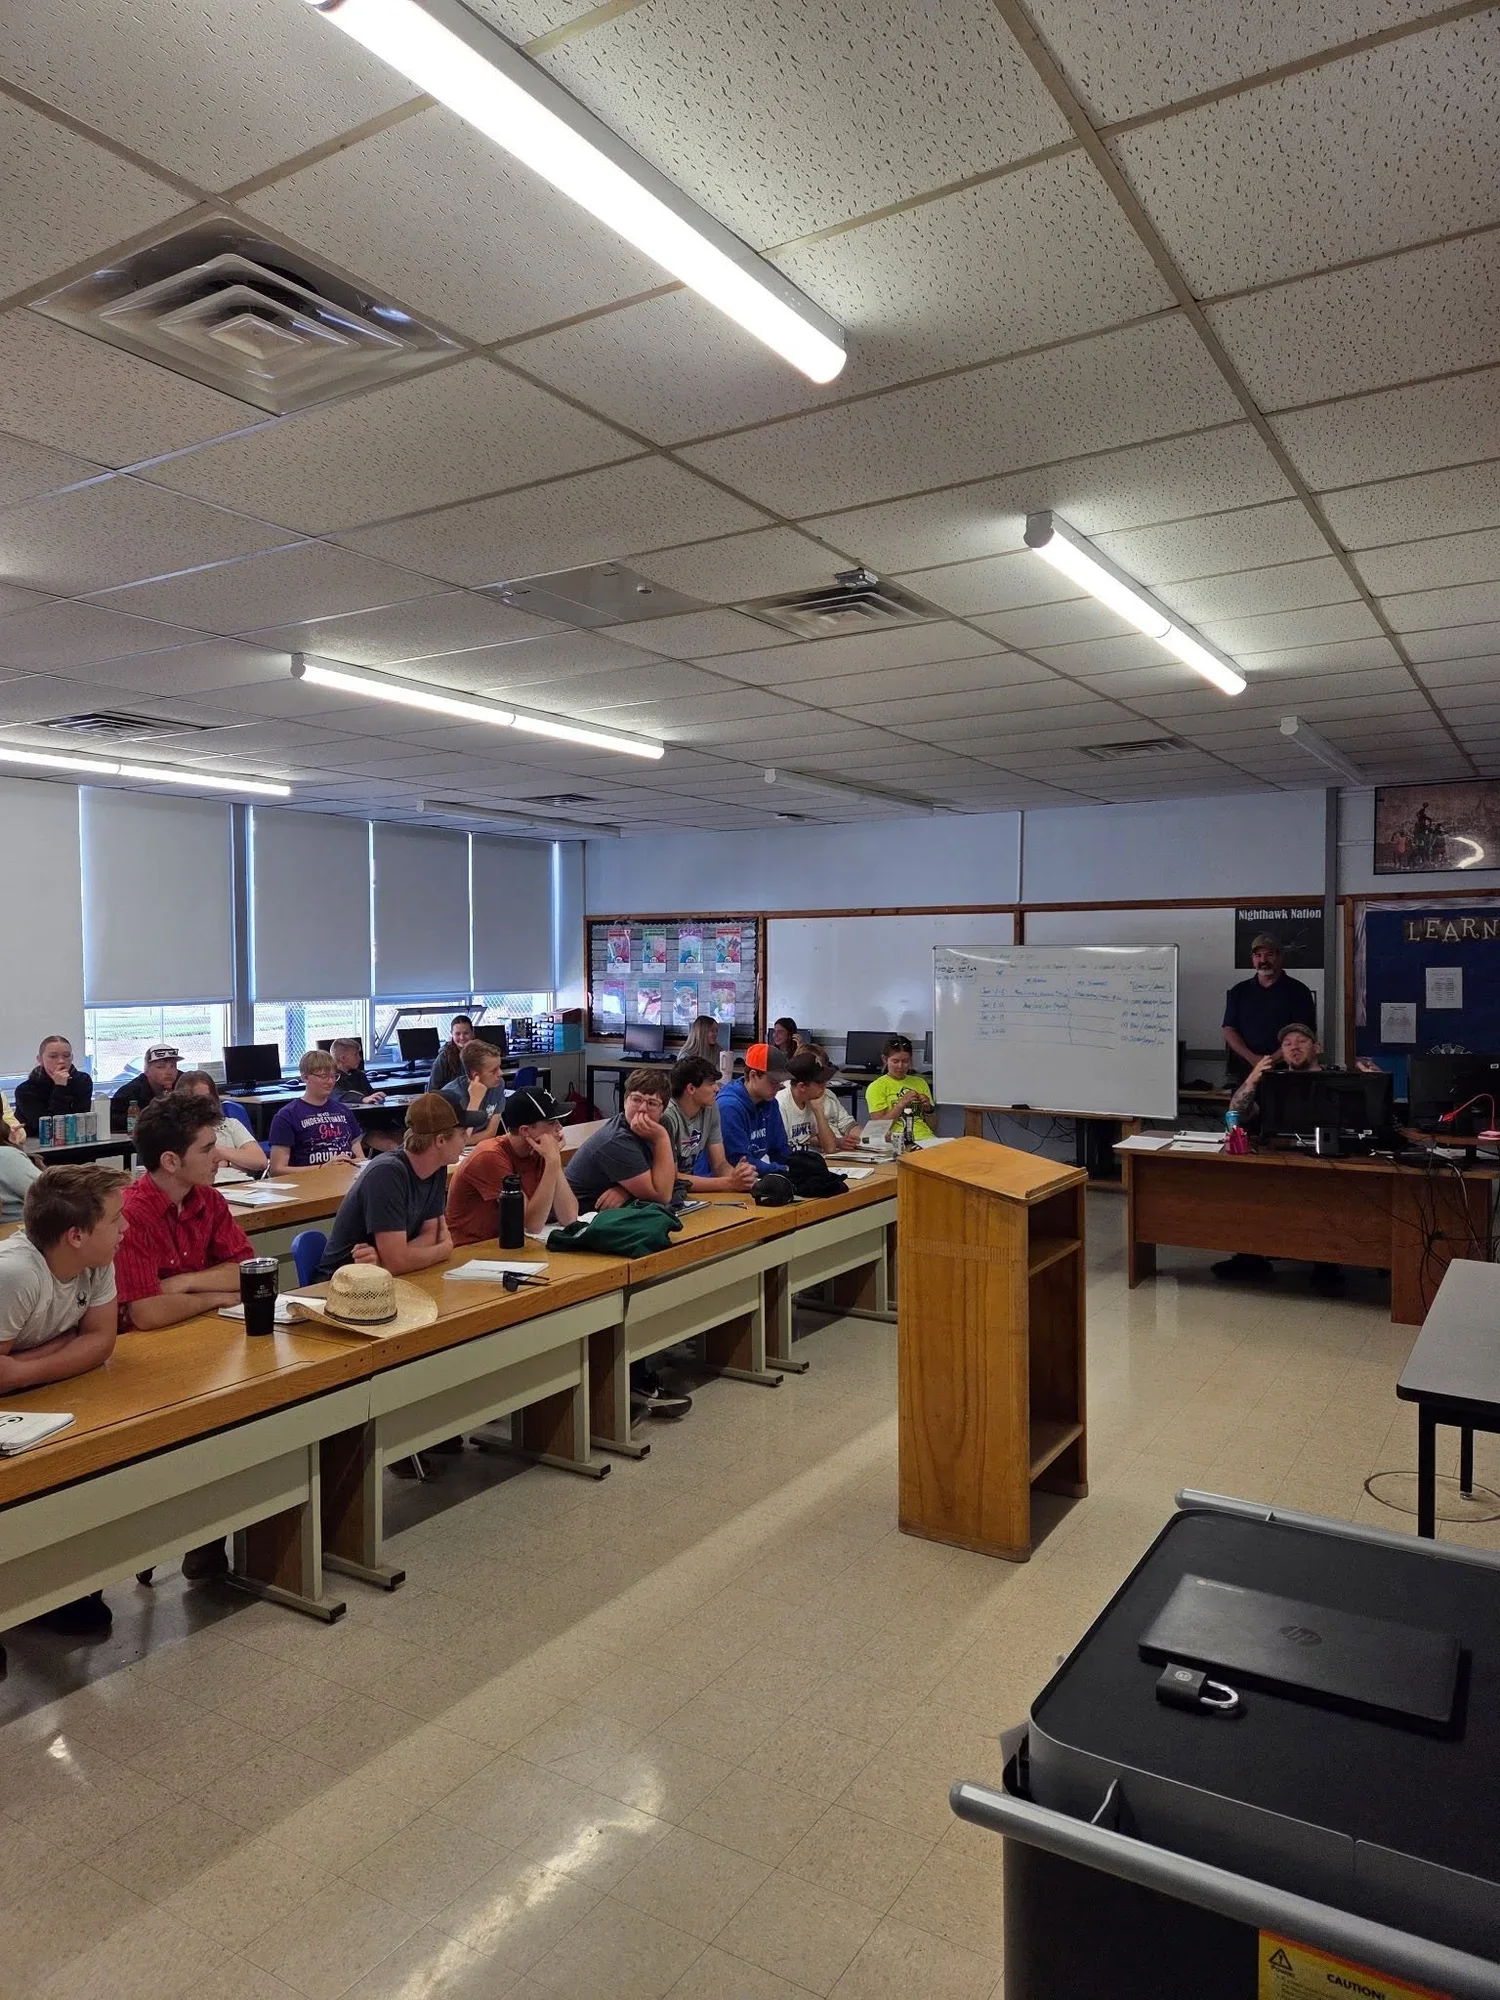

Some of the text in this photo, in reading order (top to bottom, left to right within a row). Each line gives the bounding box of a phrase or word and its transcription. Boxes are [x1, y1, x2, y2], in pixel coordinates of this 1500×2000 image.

[1239, 908, 1321, 920] Nighthawk Nation
[1408, 918, 1499, 942] LEARN
[301, 1115, 347, 1128] UNDERESTIMATE
[319, 1124, 342, 1139] Girl
[309, 1151, 337, 1164] DRUM
[1327, 1973, 1386, 2000] CAUTION!
